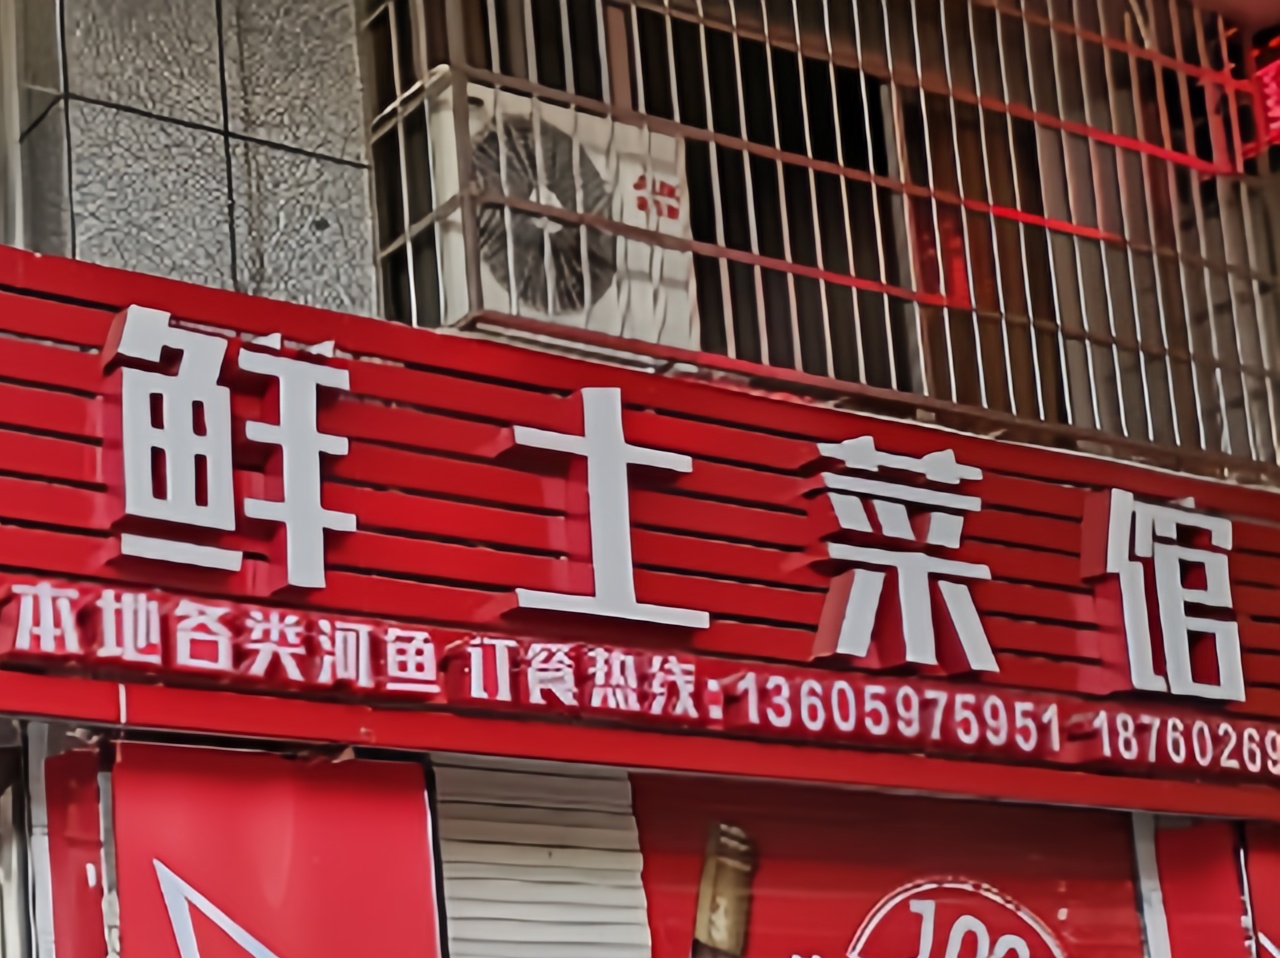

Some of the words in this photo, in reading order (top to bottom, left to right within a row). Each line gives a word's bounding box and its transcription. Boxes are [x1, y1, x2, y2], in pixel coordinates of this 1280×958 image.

[11, 581, 442, 694] 本地各类河鱼
